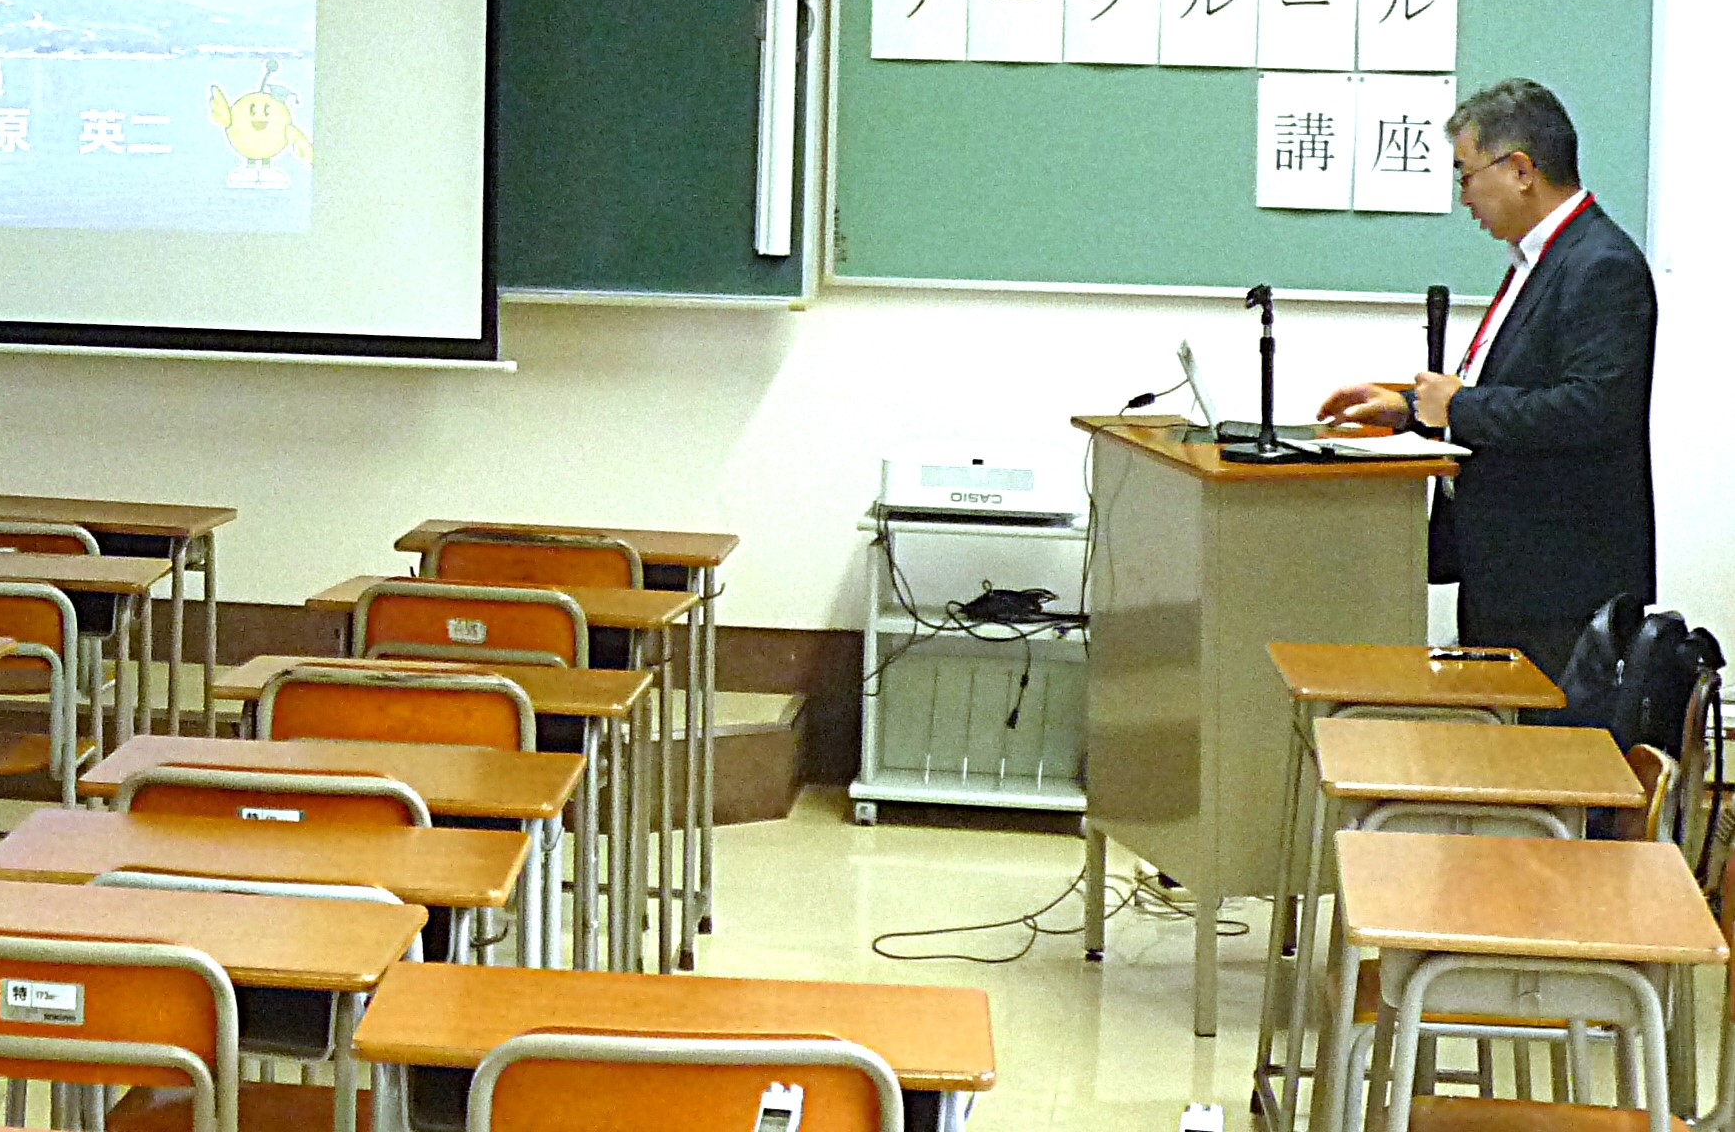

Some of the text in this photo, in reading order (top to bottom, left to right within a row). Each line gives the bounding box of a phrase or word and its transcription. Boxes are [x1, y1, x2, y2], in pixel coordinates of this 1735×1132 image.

[77, 108, 174, 155] 英二
[1274, 111, 1433, 175] 講座
[950, 491, 1003, 505] CASIO
